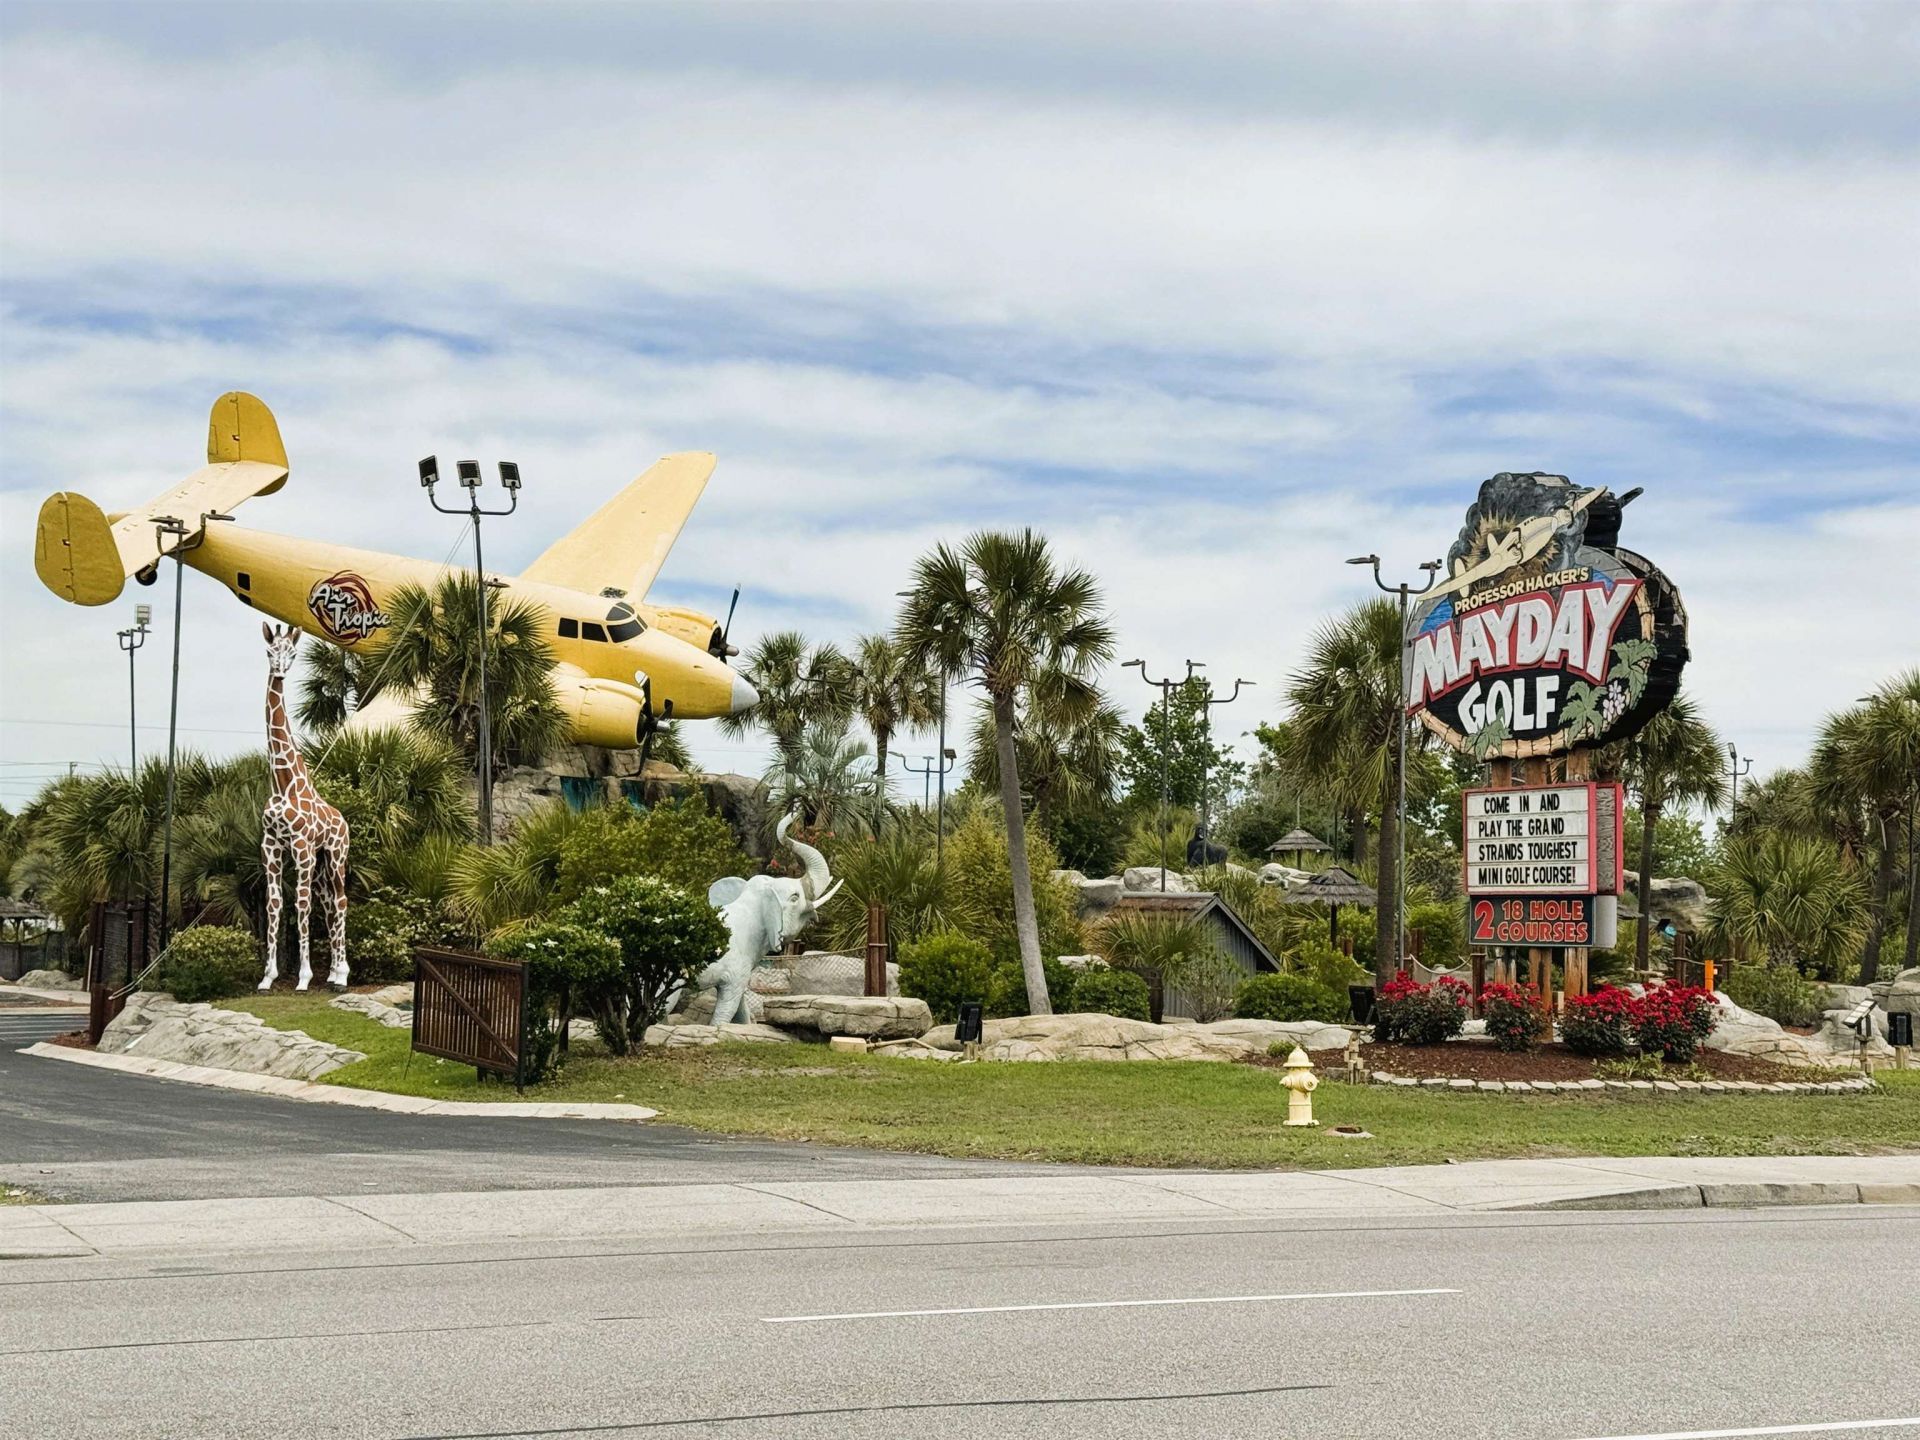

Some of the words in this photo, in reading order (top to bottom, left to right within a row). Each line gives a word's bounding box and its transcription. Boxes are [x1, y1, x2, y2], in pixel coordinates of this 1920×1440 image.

[309, 583, 356, 607] Air
[1454, 581, 1524, 614] PROFESSOR
[1525, 566, 1589, 594] HACKER'S
[327, 603, 392, 637] Tropic
[1408, 583, 1637, 708] MAYDAY
[1457, 675, 1560, 734] GOLF
[1484, 797, 1510, 814] COME
[1519, 795, 1530, 812] IN
[1539, 793, 1560, 811] AND
[1478, 819, 1502, 837] PLAY
[1506, 819, 1523, 836] THE
[1528, 817, 1564, 836] GRAND
[1478, 843, 1523, 861] STRANDS
[1528, 841, 1577, 860] TOUGHEST
[1478, 867, 1502, 884] MINI
[1505, 866, 1530, 884] GOLF
[1533, 866, 1576, 884] COURSE!
[1474, 900, 1495, 940] 2
[1502, 899, 1524, 920] 18
[1530, 900, 1584, 921] HOLE
[1497, 922, 1589, 943] COURSES
